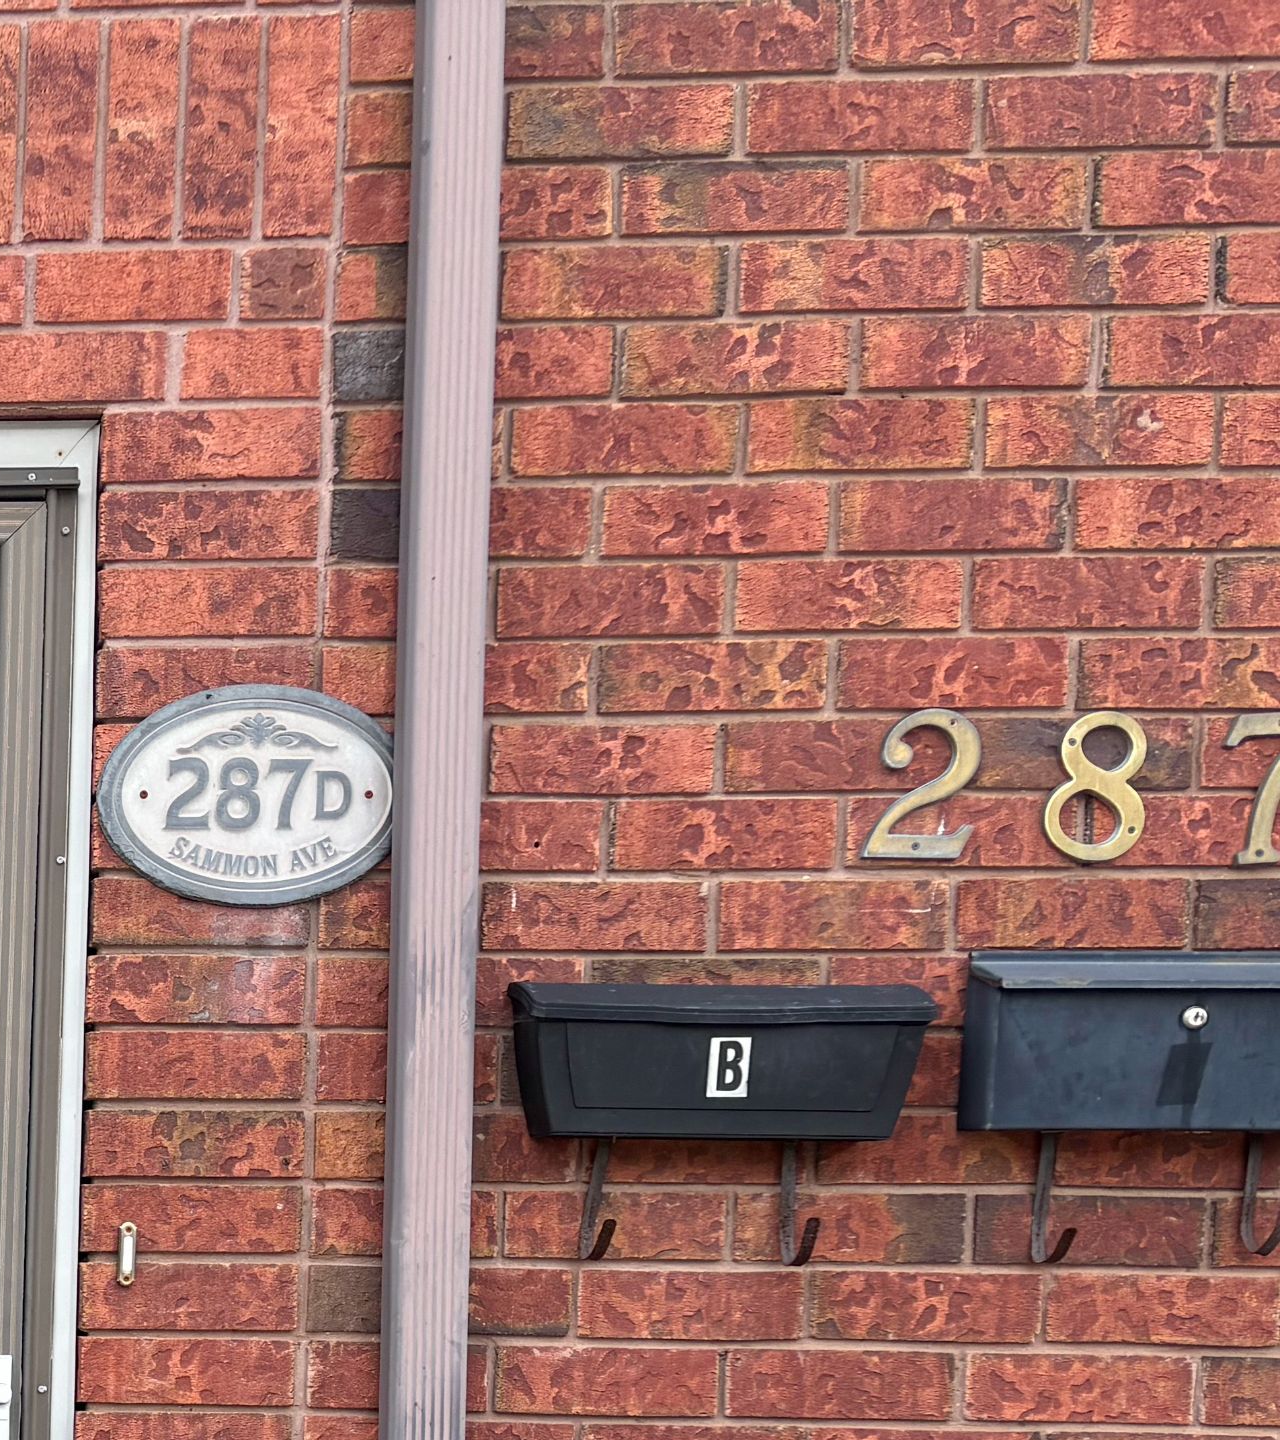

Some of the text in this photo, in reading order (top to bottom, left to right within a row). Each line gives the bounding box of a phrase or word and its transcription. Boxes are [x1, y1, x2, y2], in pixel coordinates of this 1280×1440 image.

[162, 757, 353, 831] 287D
[169, 835, 337, 877] SAMMON AVE
[716, 1041, 744, 1091] B
